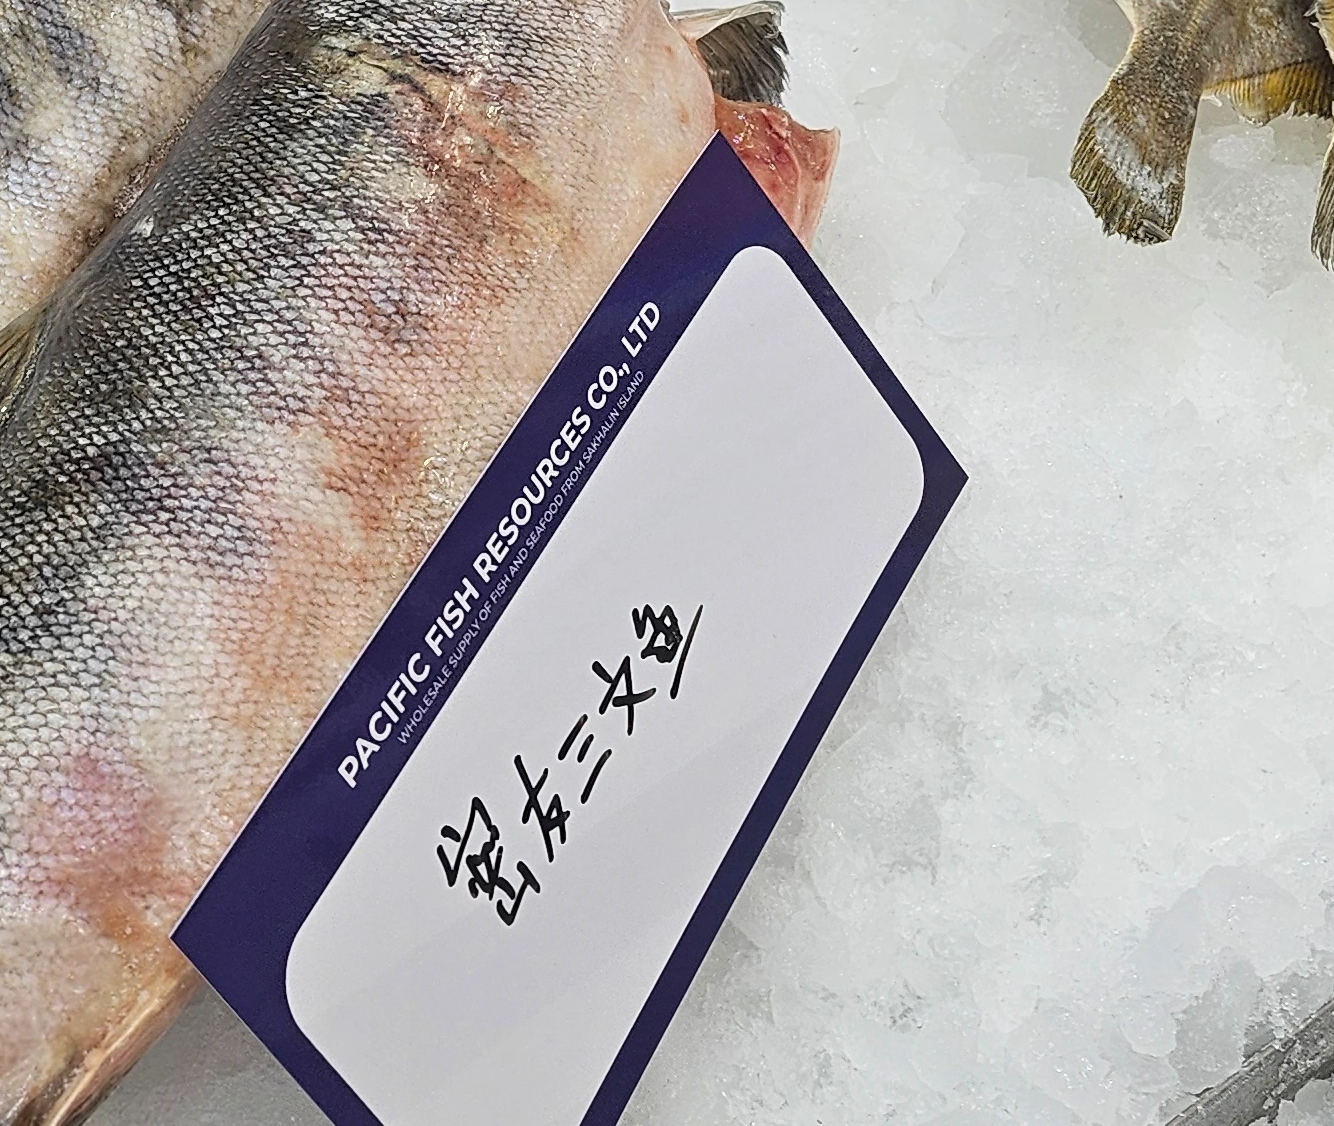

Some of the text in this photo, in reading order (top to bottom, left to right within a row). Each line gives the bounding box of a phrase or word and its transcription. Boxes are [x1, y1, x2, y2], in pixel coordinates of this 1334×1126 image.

[337, 301, 661, 789] PACIFIC FISH RESOURCES CO., LTD
[397, 370, 645, 744] WHOLESALE SUPPLY OF FISH AND SEAFOOD FROM SAKHALIN ISLAND
